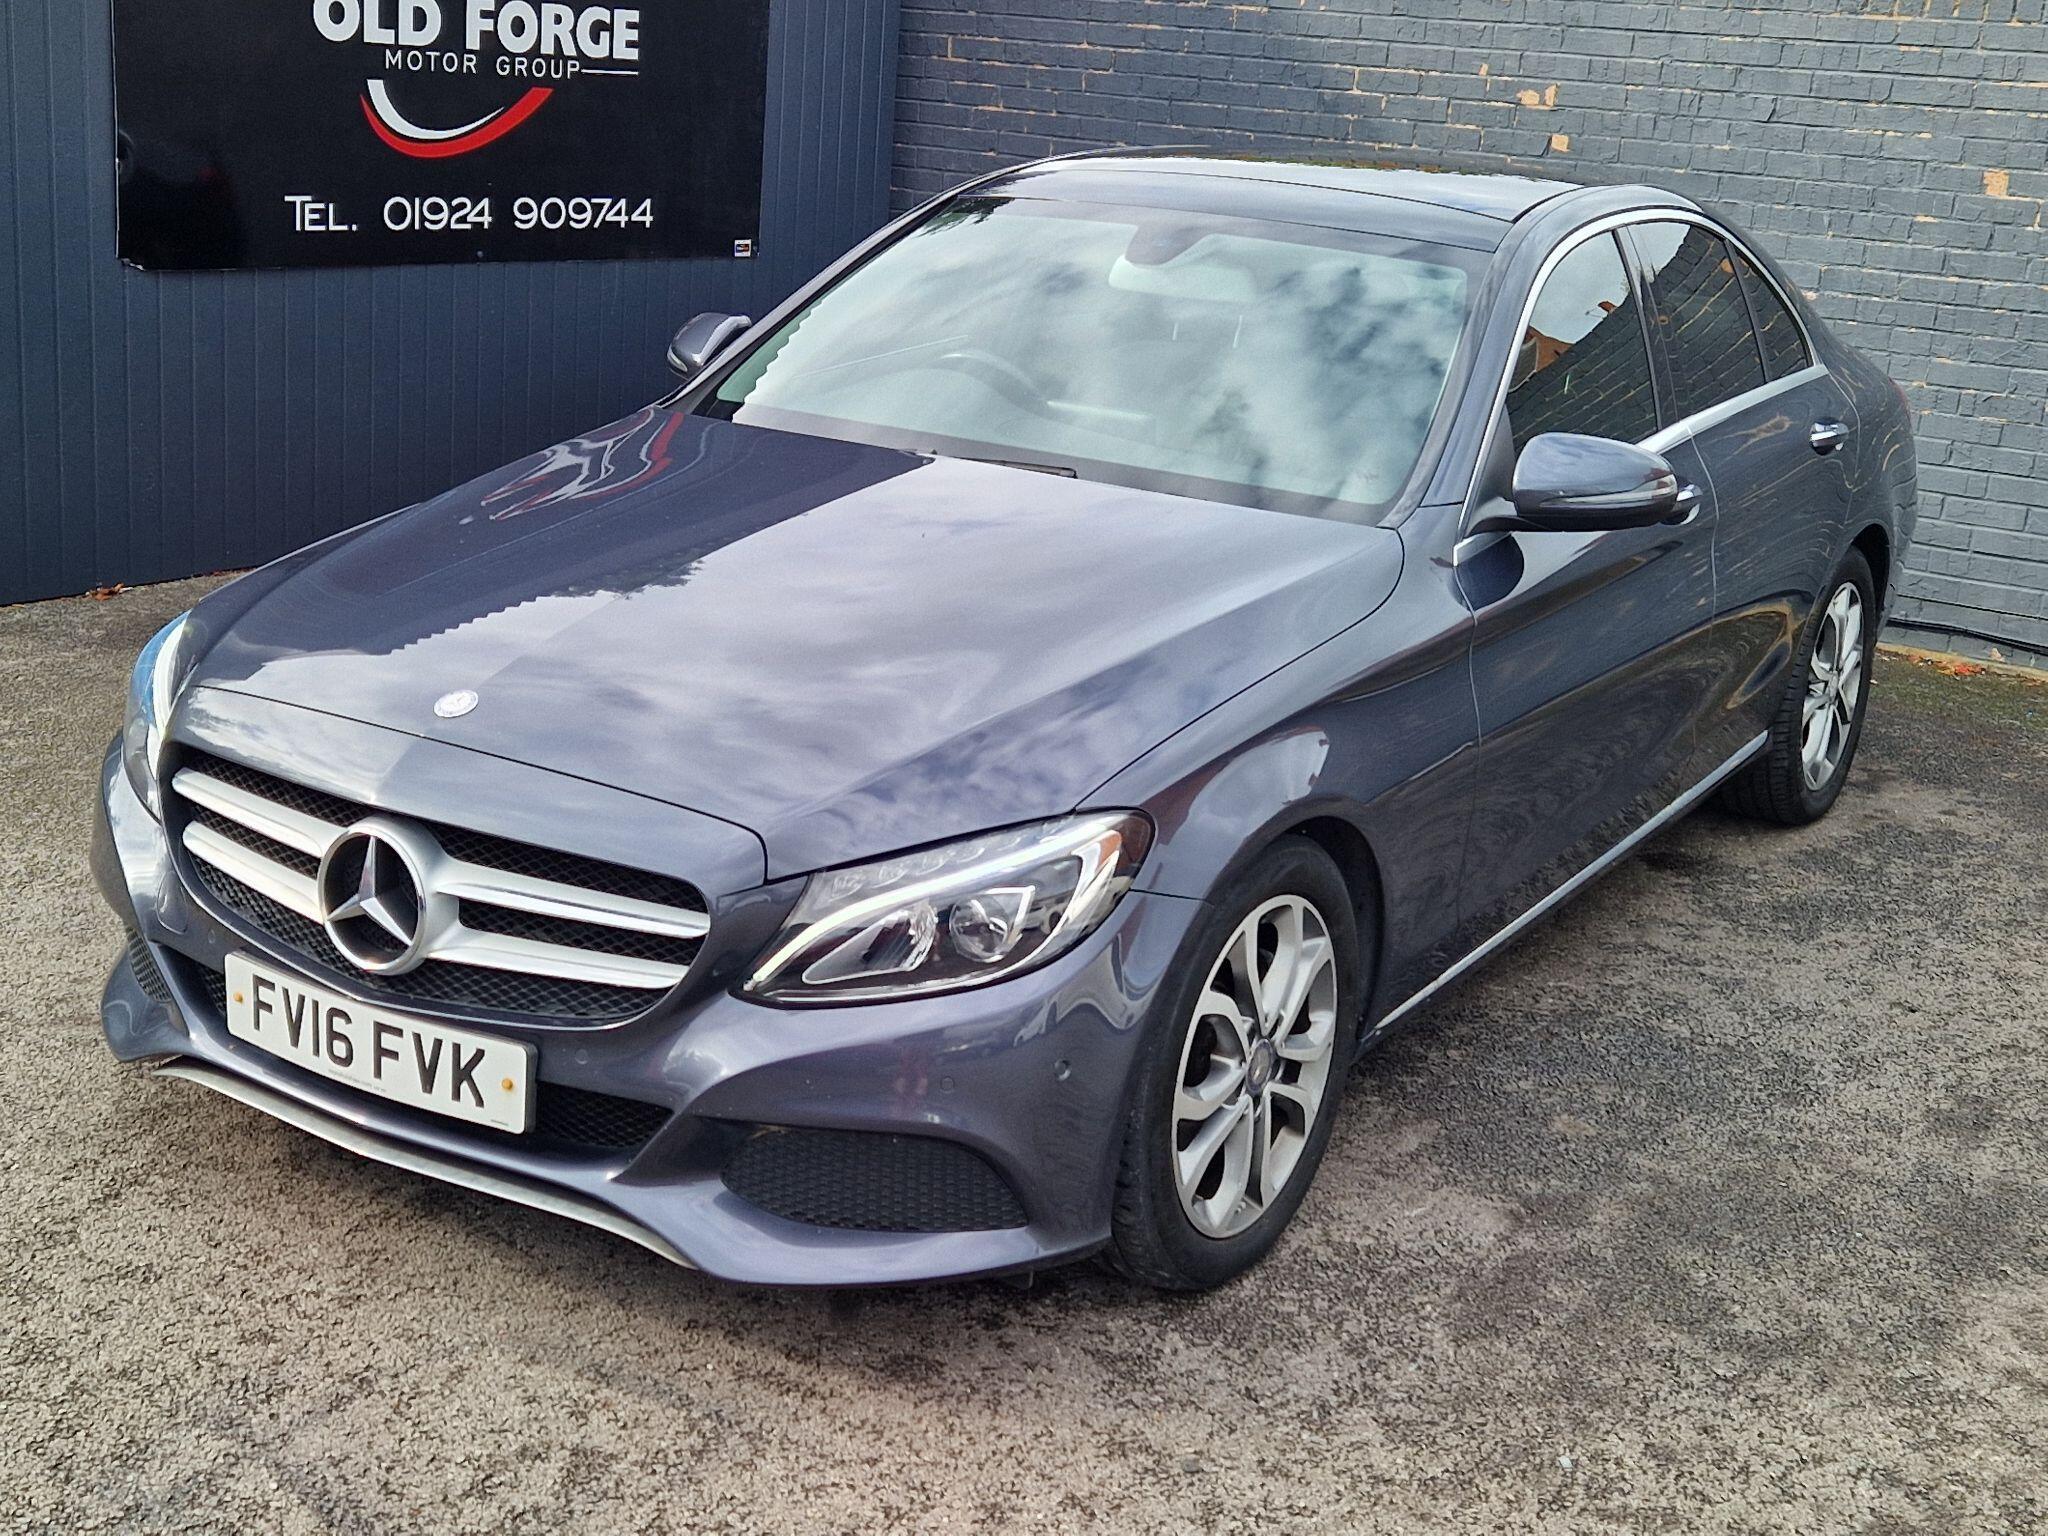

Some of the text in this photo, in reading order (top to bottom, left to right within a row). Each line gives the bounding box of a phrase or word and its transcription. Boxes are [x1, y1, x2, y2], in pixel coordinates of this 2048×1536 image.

[313, 0, 640, 60] OLD FORGE
[385, 48, 581, 79] MOTOR GROUP
[383, 196, 493, 231] 01924
[513, 197, 654, 229] 909744
[252, 973, 486, 1109] FV16 FVK
